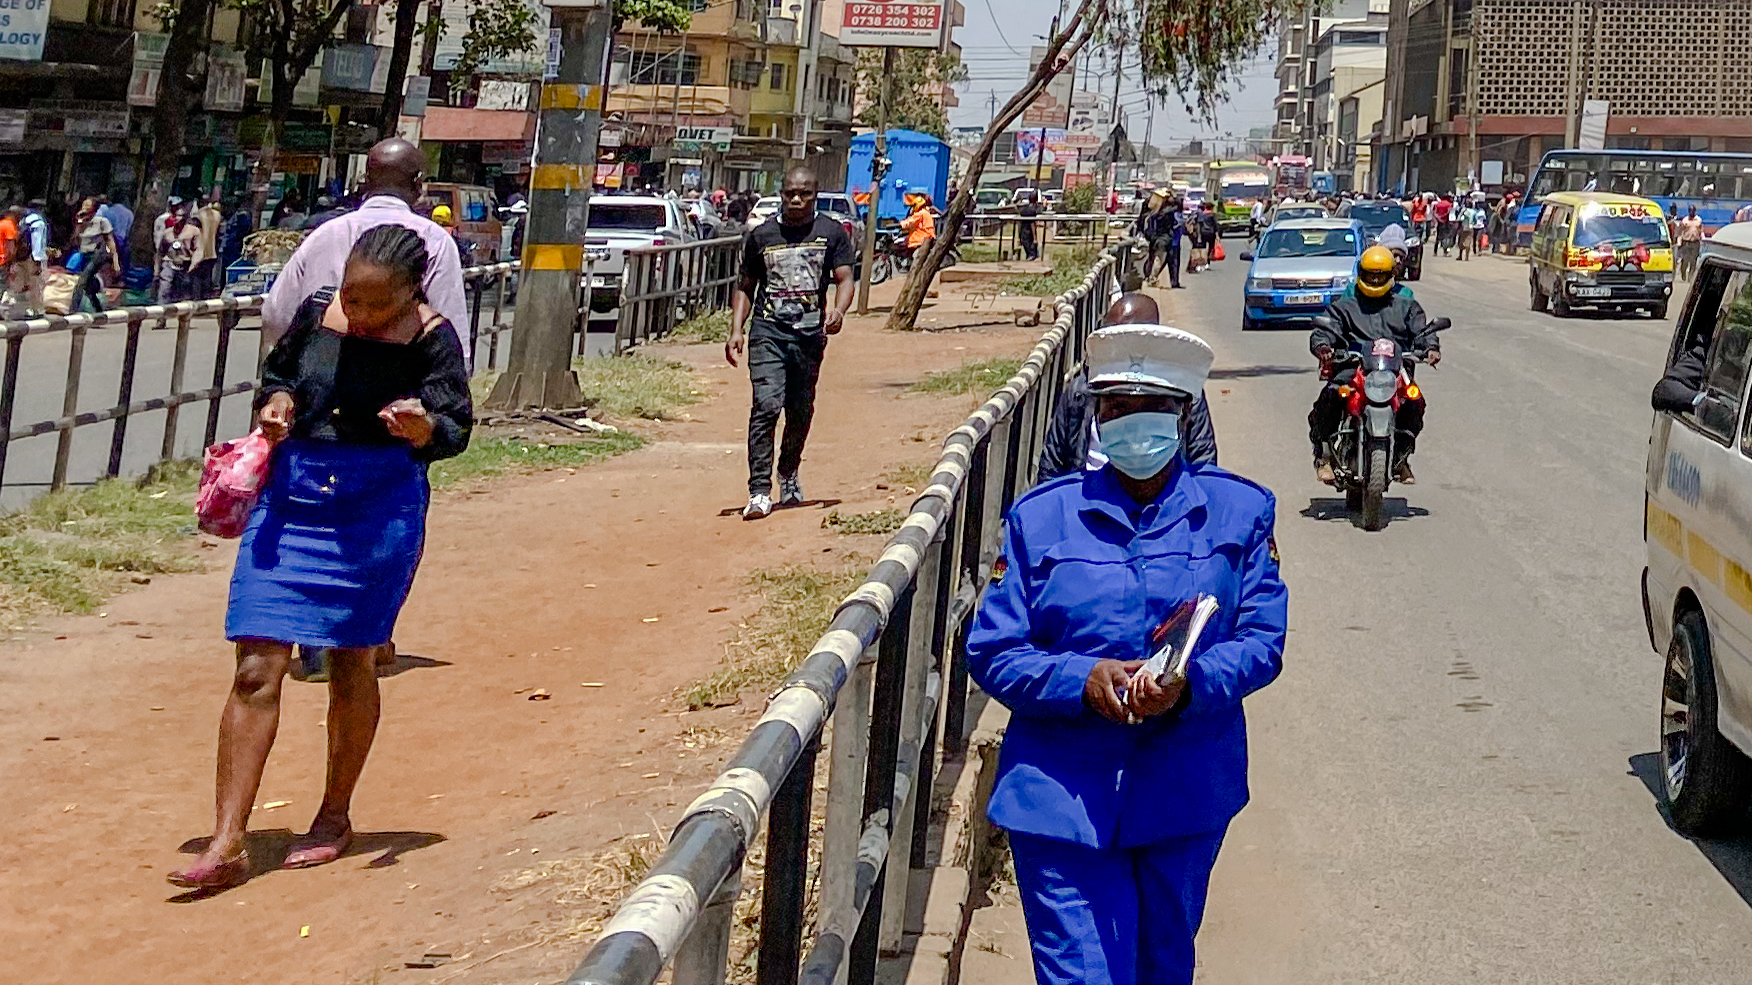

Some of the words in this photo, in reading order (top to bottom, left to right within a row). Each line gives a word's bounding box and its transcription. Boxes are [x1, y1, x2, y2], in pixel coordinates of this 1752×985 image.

[886, 5, 909, 15] 354
[912, 6, 936, 16] 302
[851, 16, 881, 26] 0738
[885, 17, 908, 27] 200
[911, 18, 934, 28] 302
[0, 32, 41, 45] LOGY
